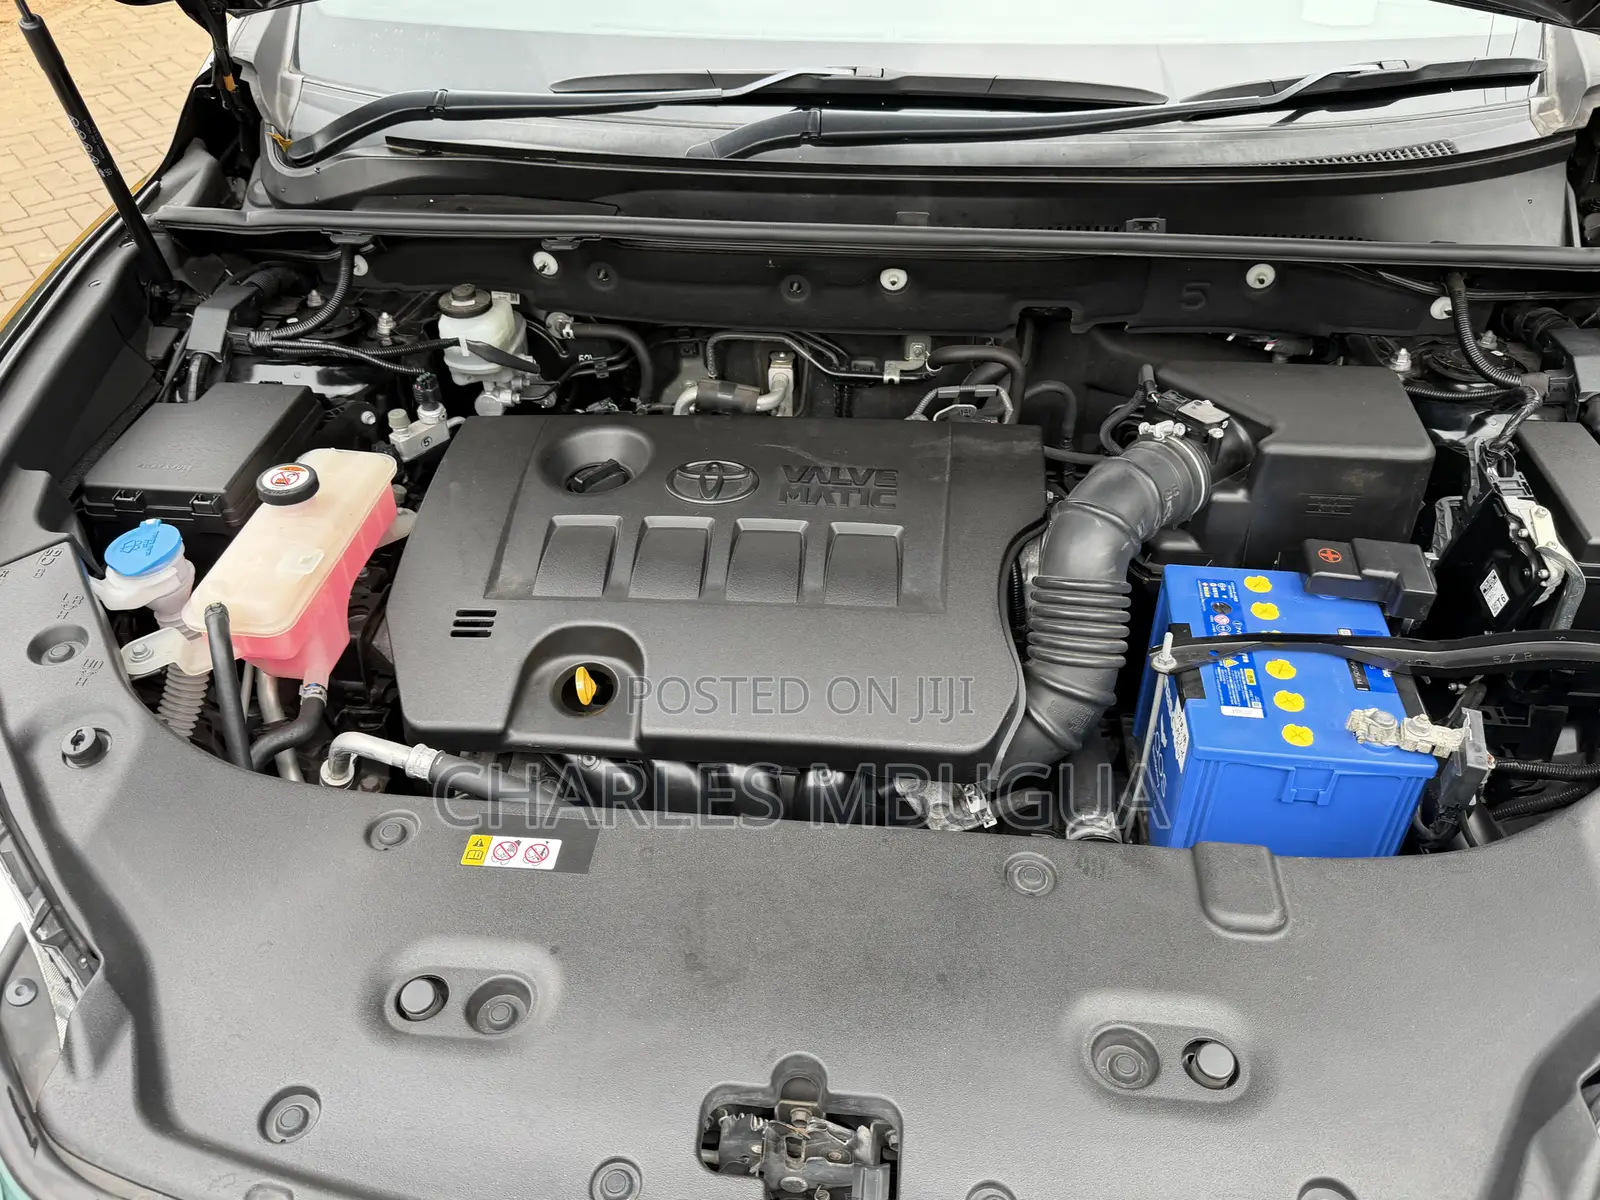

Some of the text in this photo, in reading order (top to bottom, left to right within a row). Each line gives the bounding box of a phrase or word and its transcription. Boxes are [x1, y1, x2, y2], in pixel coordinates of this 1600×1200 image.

[1180, 281, 1210, 311] 5
[780, 464, 899, 488] VALVE
[777, 486, 898, 508] MATIC
